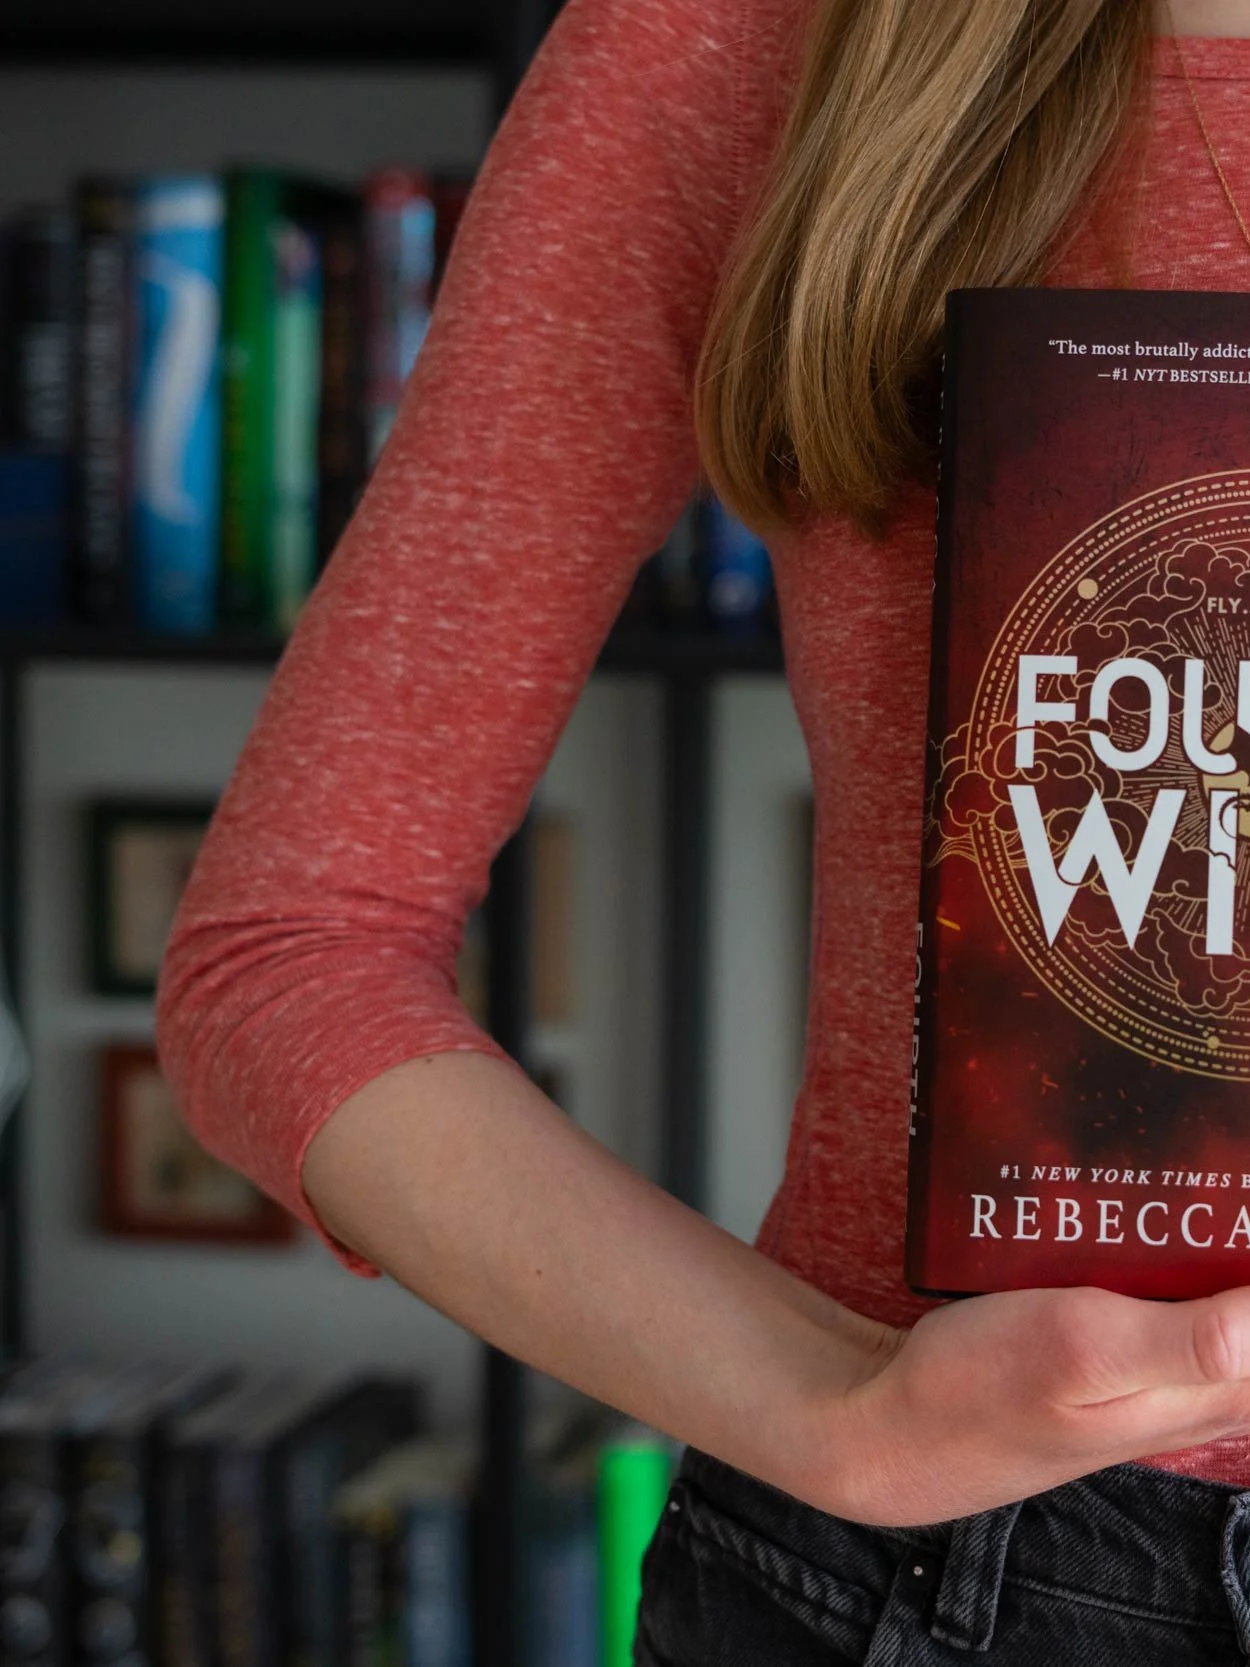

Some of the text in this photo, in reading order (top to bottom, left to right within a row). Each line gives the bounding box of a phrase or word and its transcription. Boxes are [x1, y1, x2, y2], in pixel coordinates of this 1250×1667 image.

[1049, 340, 1087, 355] “The
[1092, 342, 1131, 356] most
[1135, 342, 1198, 361] brutally
[1134, 369, 1168, 382] NYT
[1000, 1165, 1021, 1180] #1
[1031, 1166, 1082, 1182] NEW
[1091, 1168, 1152, 1184] YORK
[1161, 1171, 1232, 1188] TIMES
